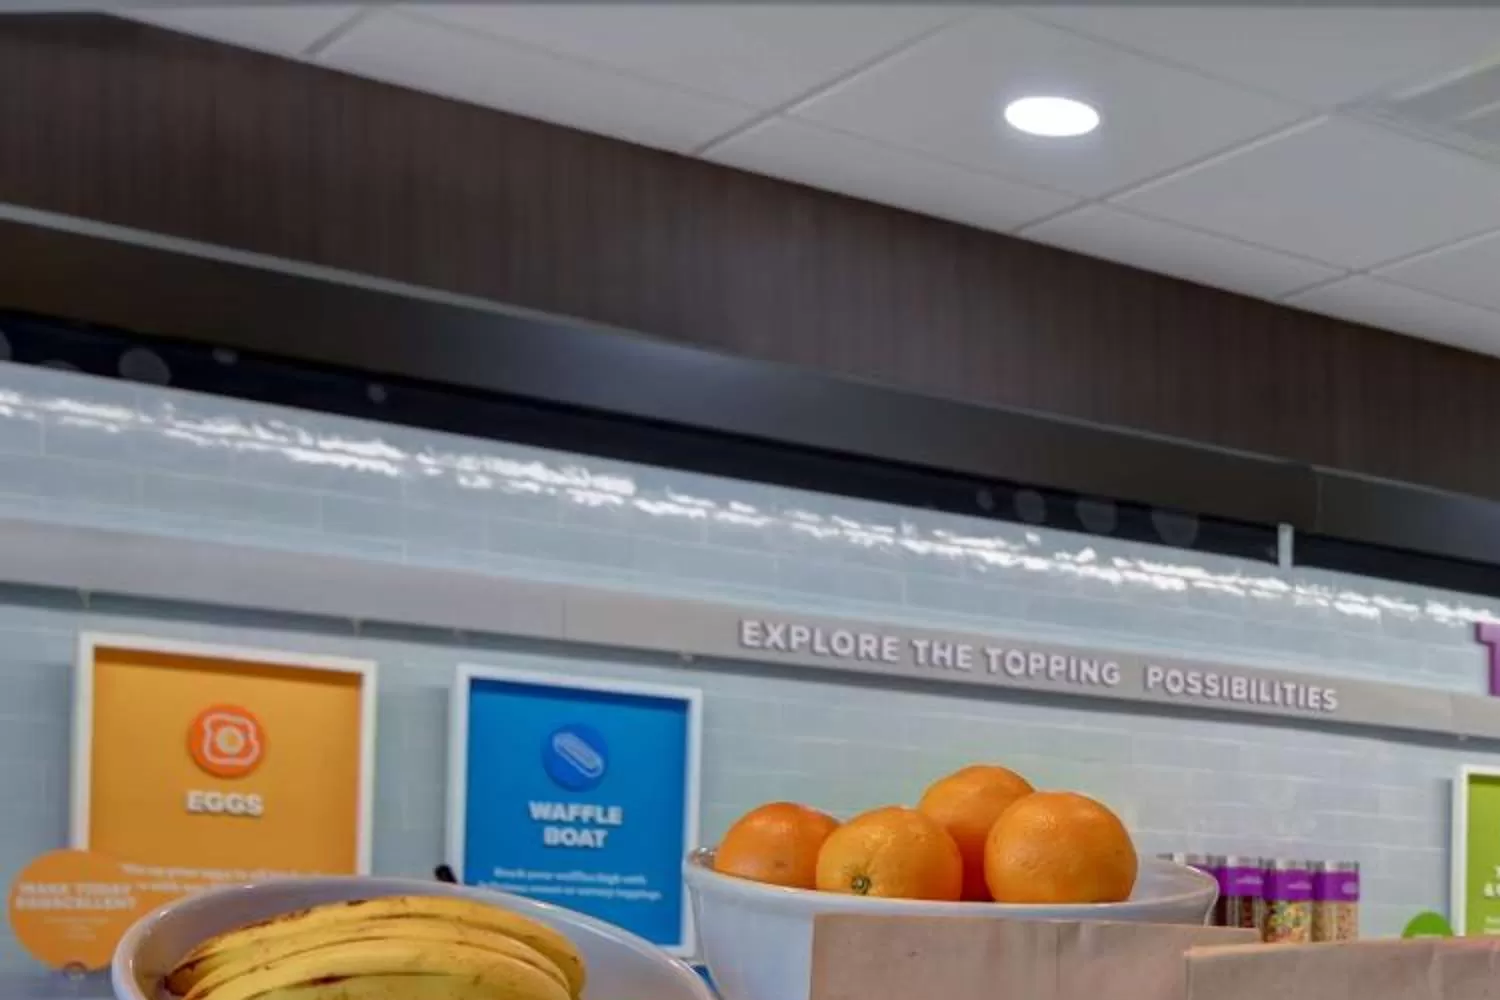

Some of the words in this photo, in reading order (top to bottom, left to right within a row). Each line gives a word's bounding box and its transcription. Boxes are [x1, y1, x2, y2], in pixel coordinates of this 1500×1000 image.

[741, 618, 899, 663] EXPLORE
[911, 638, 973, 672] THE
[985, 646, 1121, 687] TOPPING
[1144, 665, 1339, 712] POSSIBILITIES
[186, 790, 264, 817] EGGS
[528, 799, 623, 826] WAFFLE
[543, 826, 608, 849] BOAT
